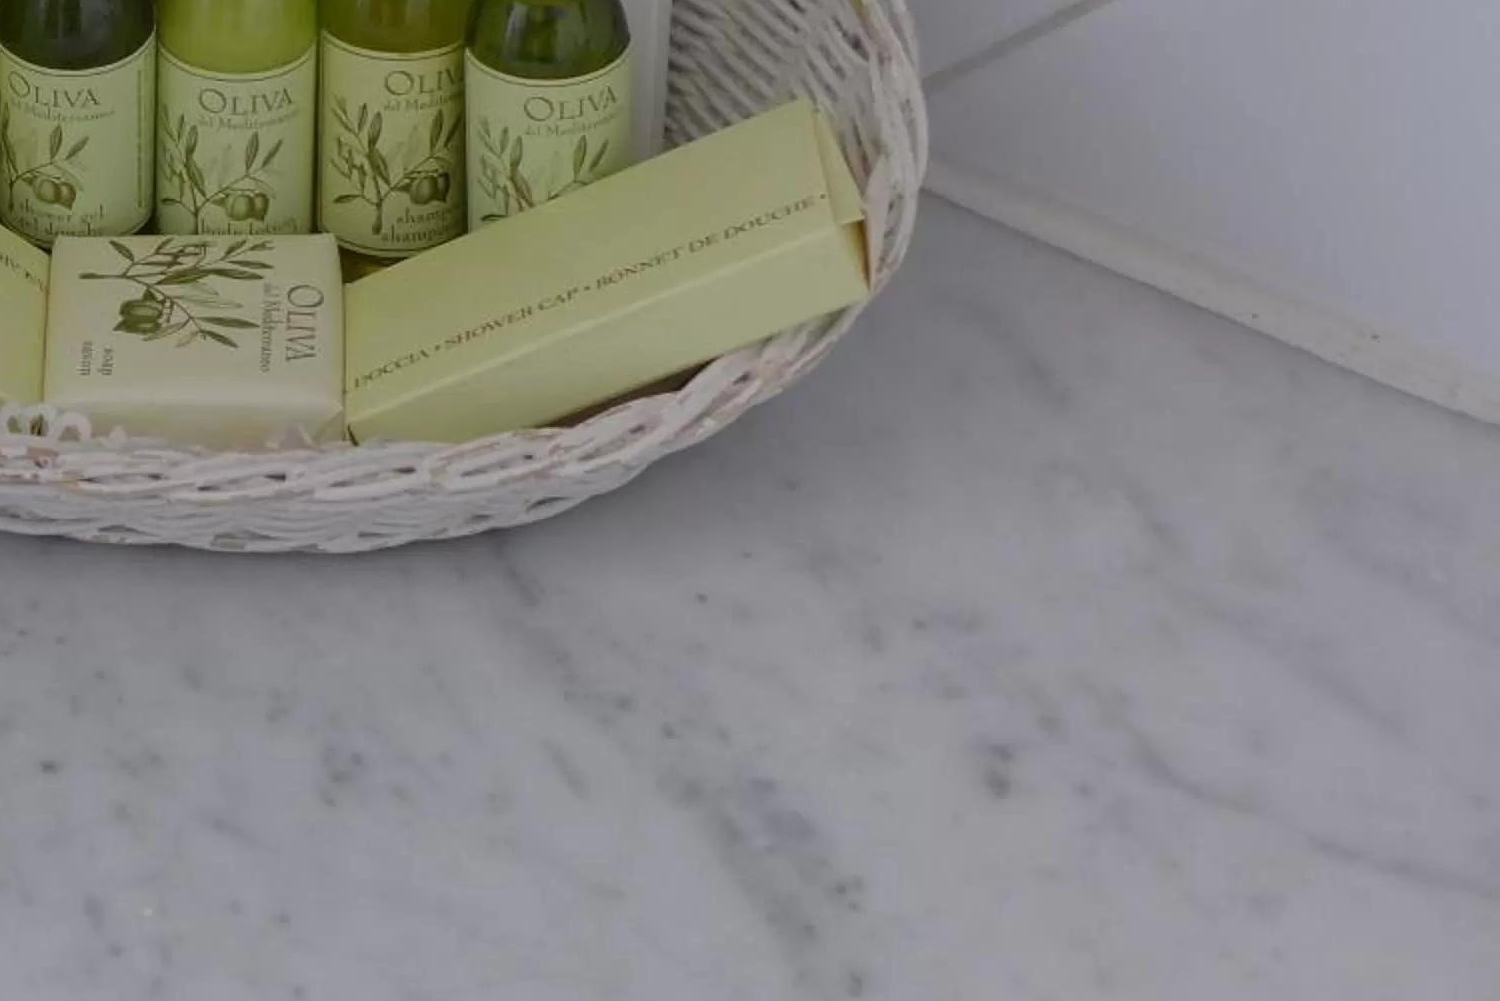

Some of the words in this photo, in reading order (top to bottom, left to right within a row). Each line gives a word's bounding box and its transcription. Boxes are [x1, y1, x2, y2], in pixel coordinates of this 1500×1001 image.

[8, 70, 102, 108] OLIVA
[383, 67, 460, 96] OLIV
[198, 86, 293, 116] OLIVA
[523, 86, 617, 122] OLIVA
[444, 305, 536, 353] SHOWER
[536, 287, 580, 311] CAP
[595, 245, 685, 289] BONNET
[687, 230, 721, 254] DE
[722, 197, 816, 240] DOUCHE
[285, 284, 325, 363] OLIVA
